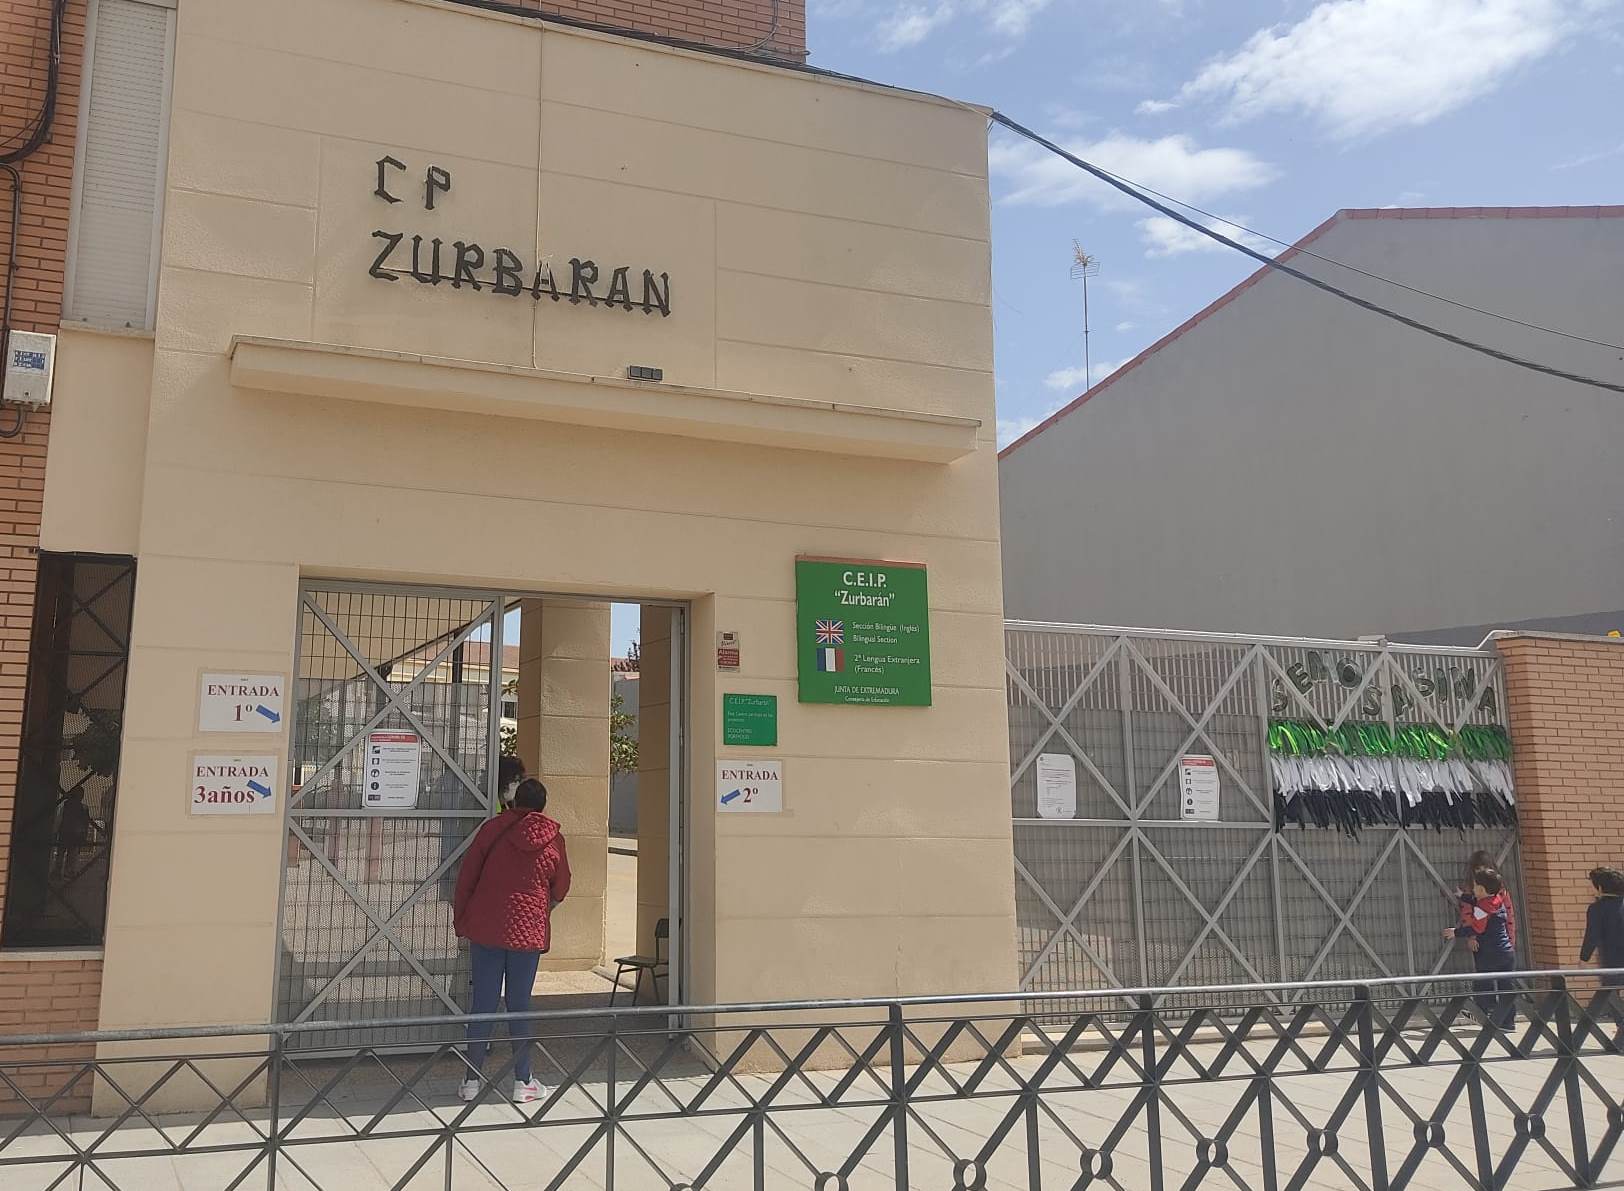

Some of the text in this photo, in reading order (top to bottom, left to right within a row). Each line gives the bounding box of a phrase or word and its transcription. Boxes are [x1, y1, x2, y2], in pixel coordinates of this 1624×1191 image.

[369, 229, 671, 318] ZURBARAN
[843, 571, 887, 588] C.E.I.P.
[852, 622, 874, 631] Sección
[899, 624, 920, 634] (Inglés)
[852, 635, 898, 644] Bilingual Section
[862, 655, 886, 664] Lengua
[887, 656, 921, 665] Extranjera
[854, 666, 885, 674] (Francés)
[207, 684, 280, 697] ENTRADA
[834, 686, 900, 695] JUNTA DE EXTREMADURA
[196, 766, 269, 778] ENTRADA
[722, 769, 778, 781] ENTRADA
[194, 785, 256, 804] 3años
